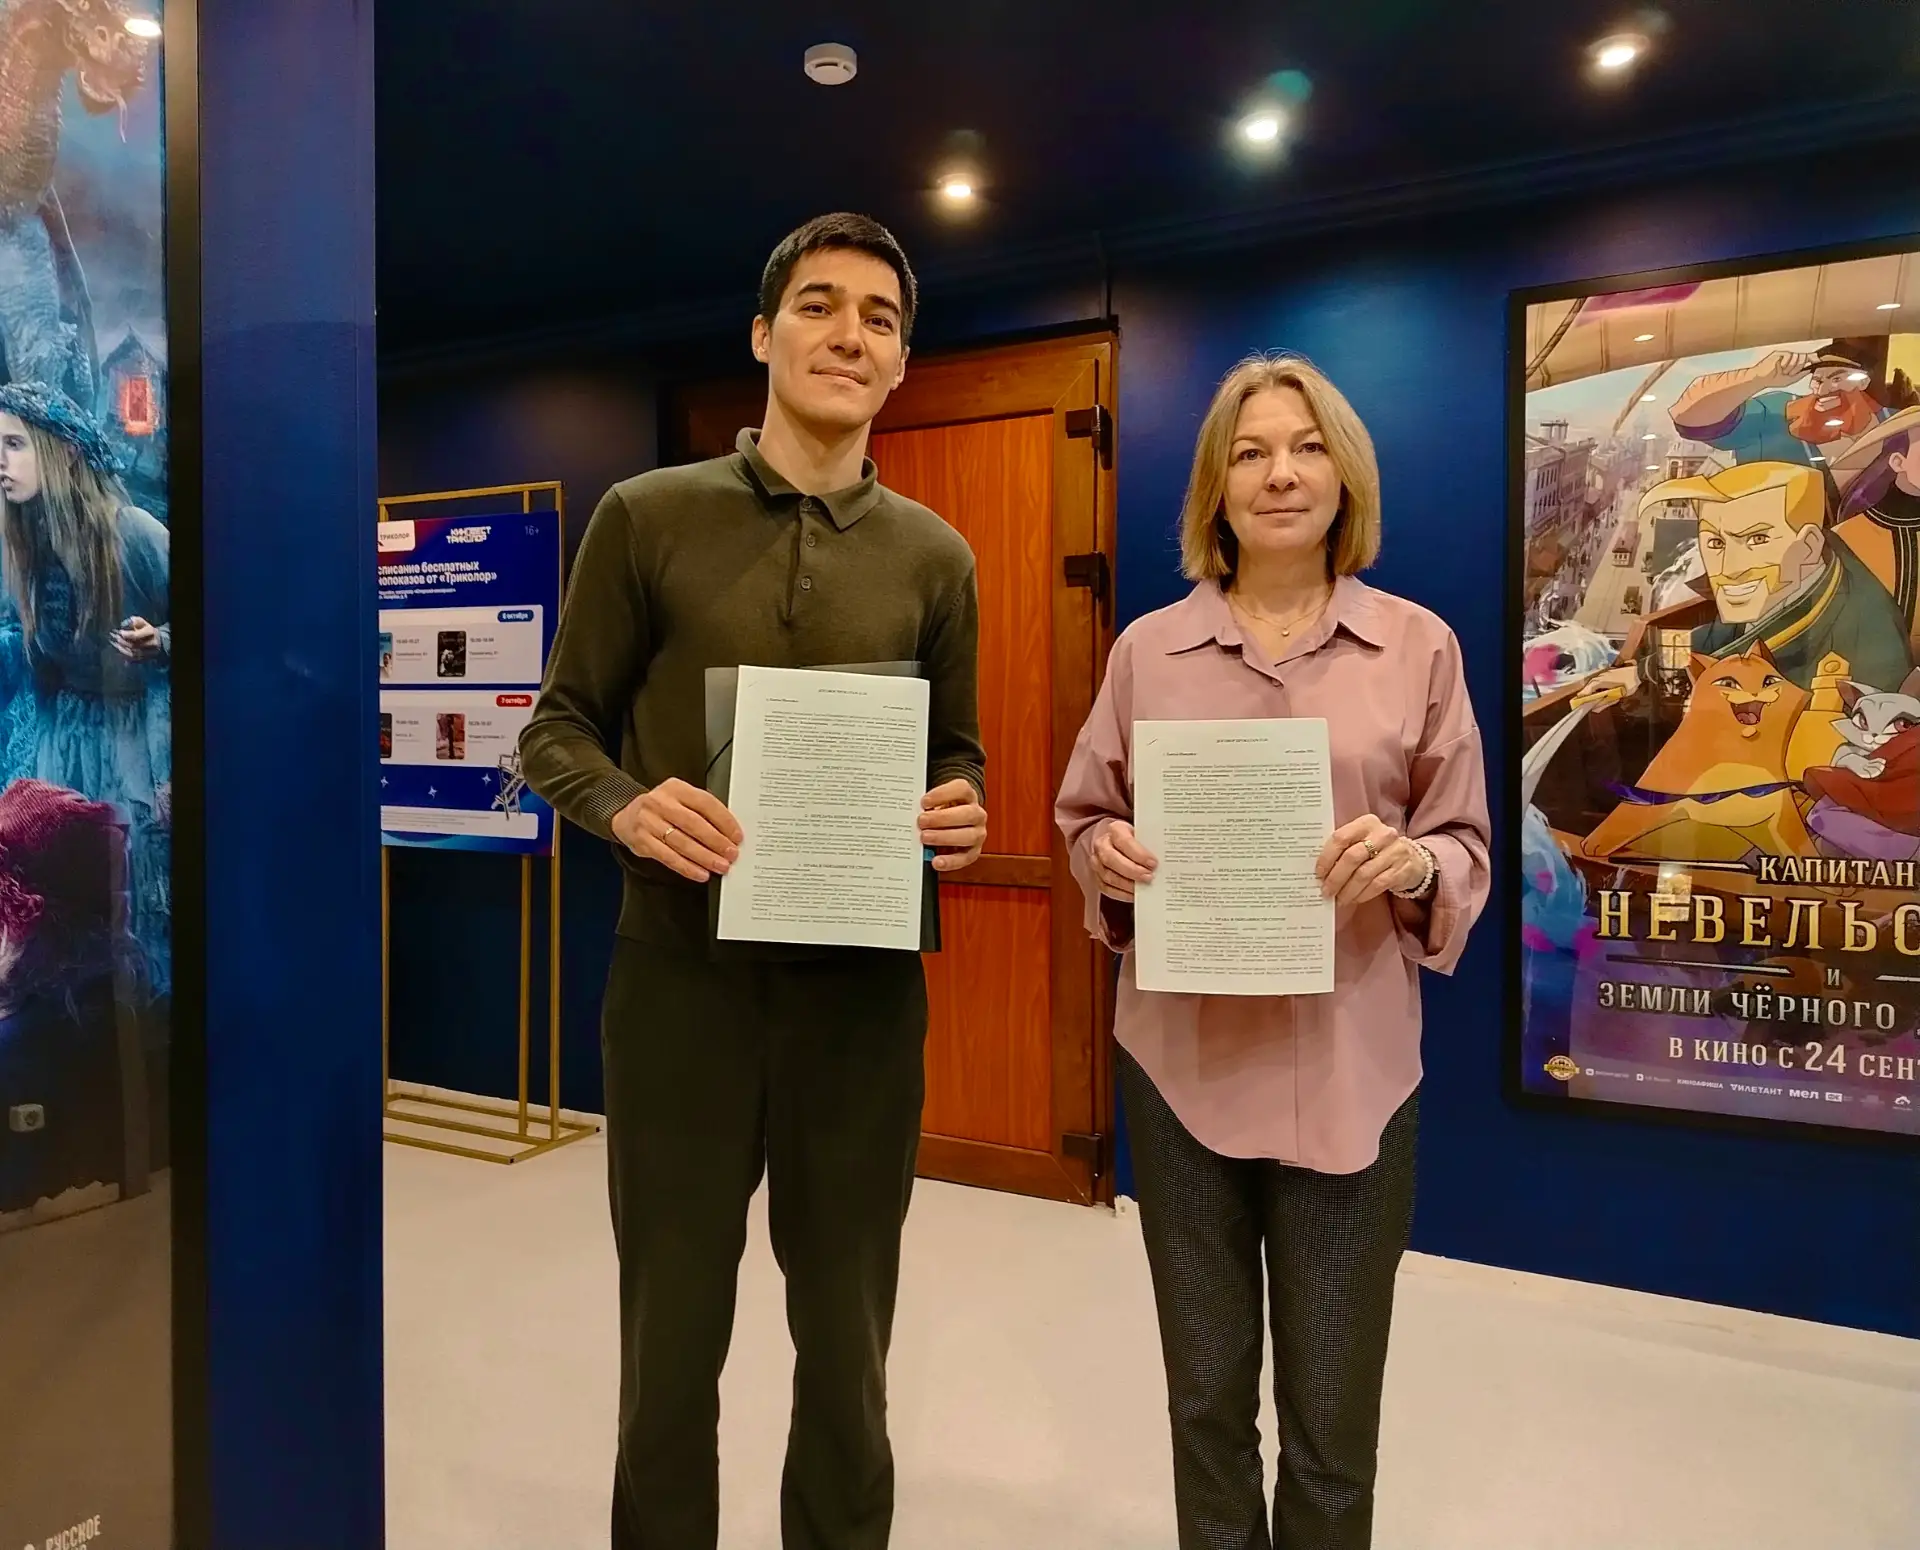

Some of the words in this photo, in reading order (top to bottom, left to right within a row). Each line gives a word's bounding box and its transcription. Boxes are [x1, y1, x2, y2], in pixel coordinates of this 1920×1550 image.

[379, 532, 410, 542] ТРИКОЛОР
[525, 525, 540, 537] 16+
[421, 561, 480, 573] бесплатных
[426, 573, 438, 584] от
[439, 571, 498, 586] «Триколор»
[1760, 857, 1914, 887] КАПИТАН
[1827, 968, 1840, 986] И
[1599, 982, 1711, 1015] ЗЕМЛИ
[1731, 985, 1896, 1030] ЧЁРНОГО
[1669, 1037, 1683, 1059] В
[1695, 1040, 1767, 1068] КИНО
[1804, 1042, 1847, 1074] 24
[1859, 1054, 1920, 1082] СЕН
[1677, 1078, 1724, 1089] КИНОАФИША
[1789, 1089, 1819, 1100] мел
